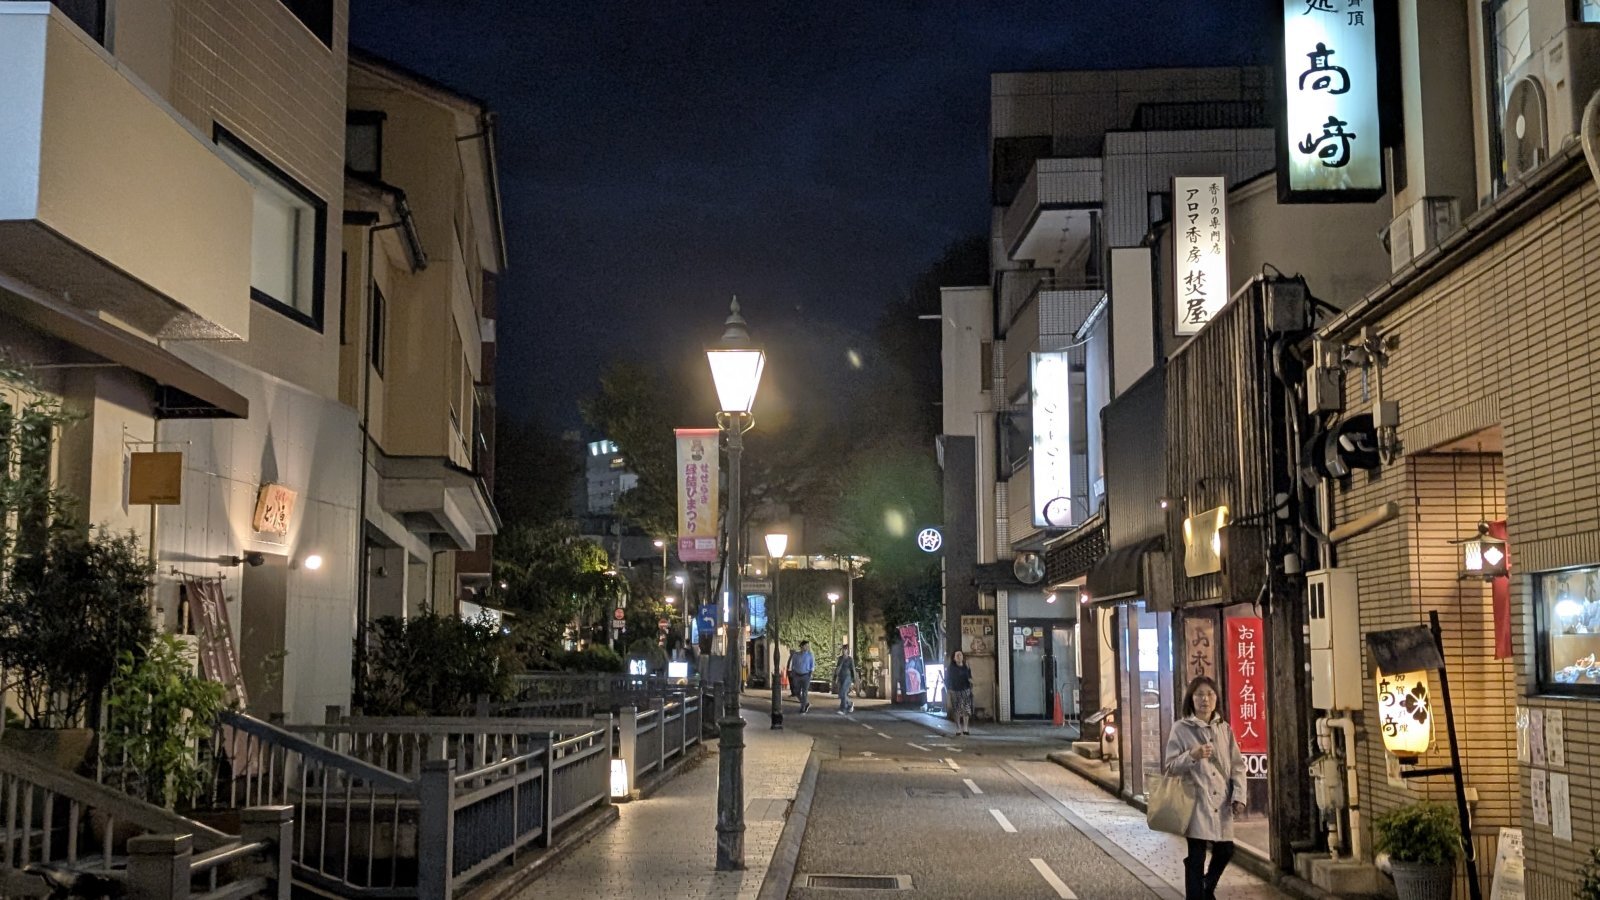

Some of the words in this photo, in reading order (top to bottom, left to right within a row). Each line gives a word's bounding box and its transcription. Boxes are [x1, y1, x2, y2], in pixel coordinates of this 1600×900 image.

[1186, 188, 1202, 264] アロマ香房
[984, 626, 992, 635] P
[1237, 624, 1259, 739] お財布・名刺入
